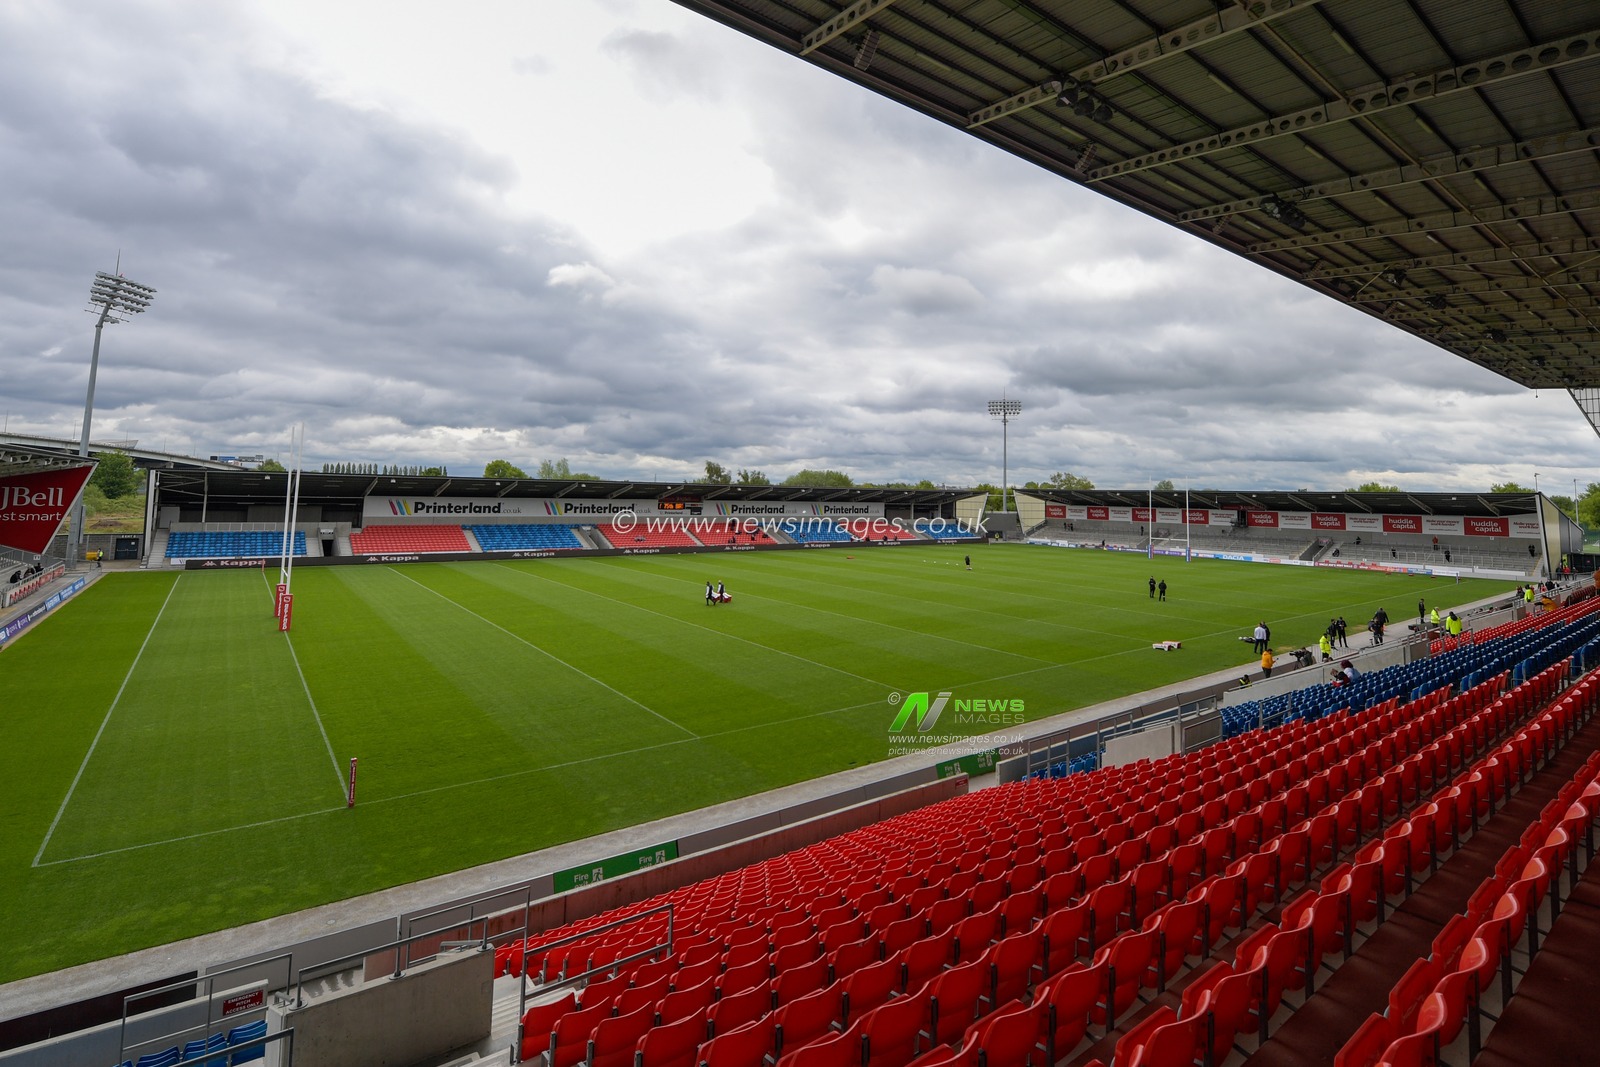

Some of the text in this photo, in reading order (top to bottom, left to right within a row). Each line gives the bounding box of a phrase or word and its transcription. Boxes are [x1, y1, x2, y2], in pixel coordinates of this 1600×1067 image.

[18, 512, 61, 520] smart
[639, 856, 653, 864] Fire
[574, 874, 589, 883] Fire
[228, 992, 258, 1004] EMERGENCY
[225, 1001, 260, 1015] ACCESS ONLY
